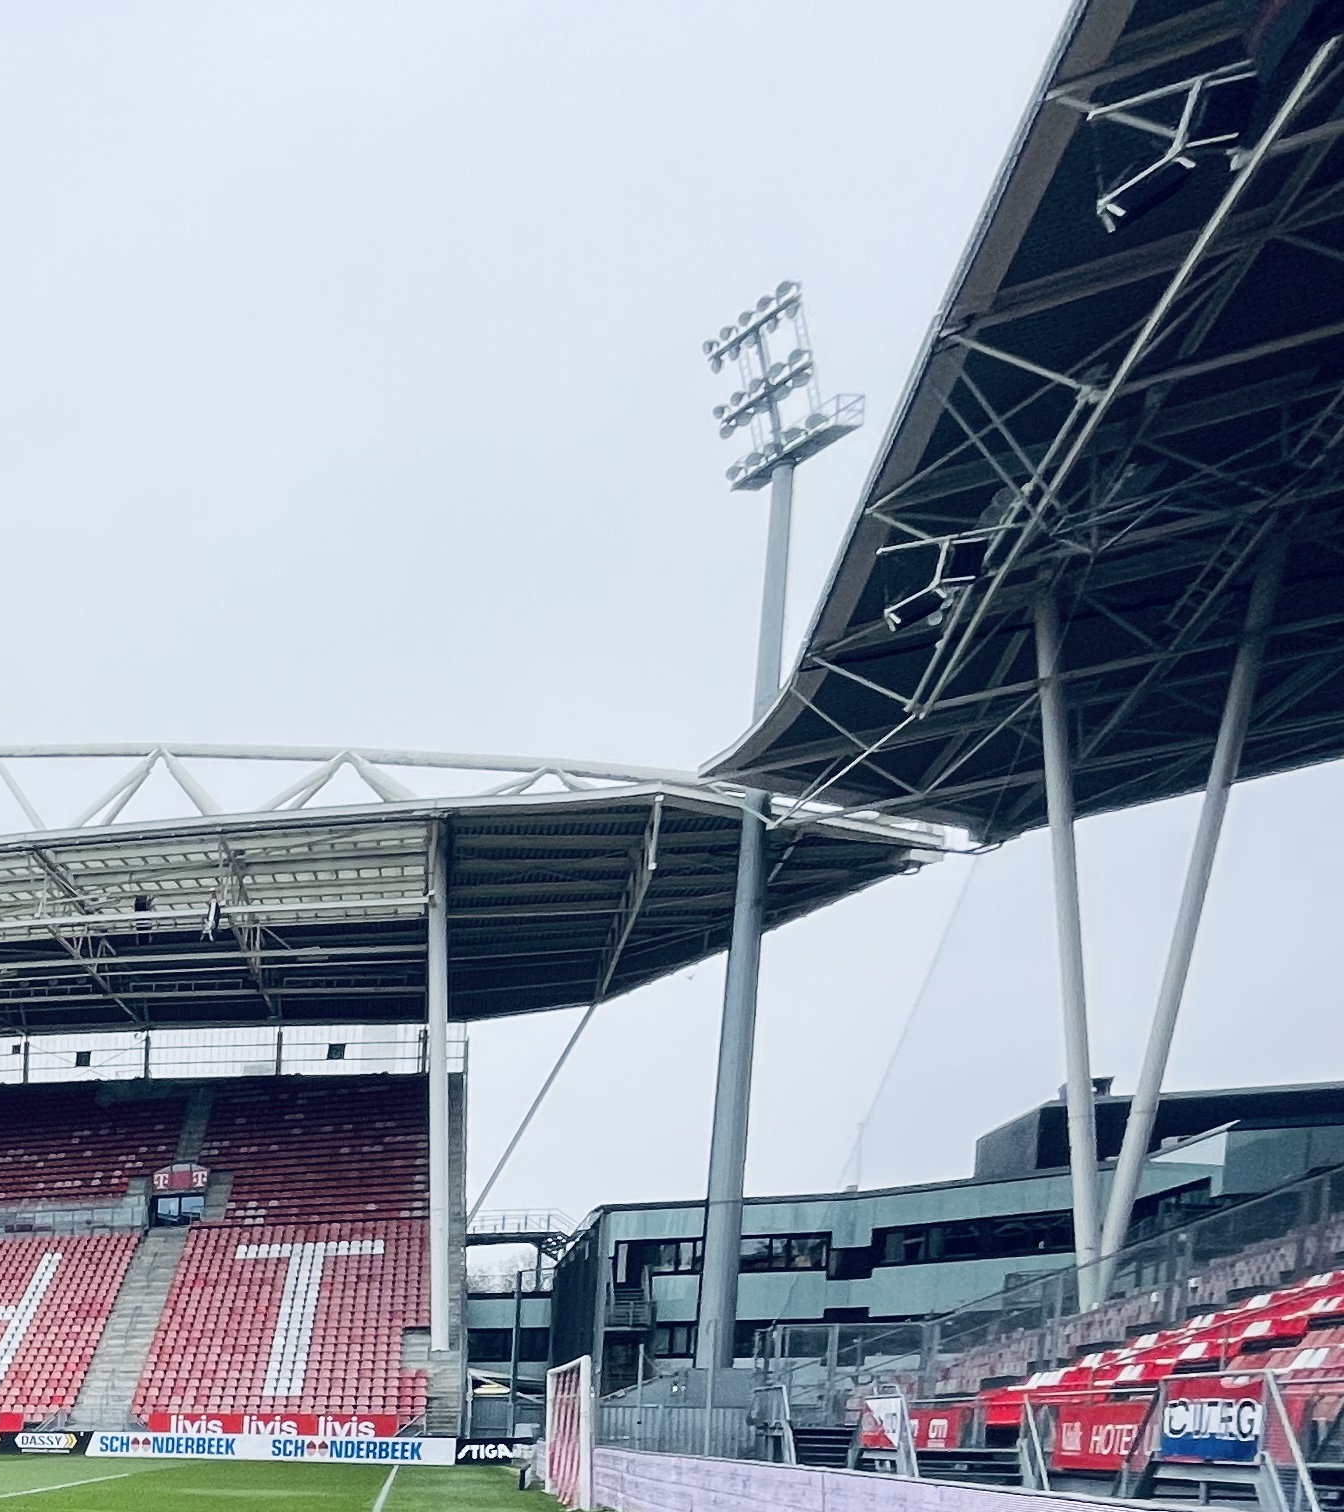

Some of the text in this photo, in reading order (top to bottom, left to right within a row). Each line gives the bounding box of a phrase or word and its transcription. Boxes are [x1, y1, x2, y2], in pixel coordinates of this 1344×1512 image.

[170, 1415, 224, 1434] livis
[243, 1415, 298, 1436] livis
[318, 1416, 376, 1438] livis
[21, 1434, 63, 1446] DASSY
[457, 1443, 513, 1460] STIGA
